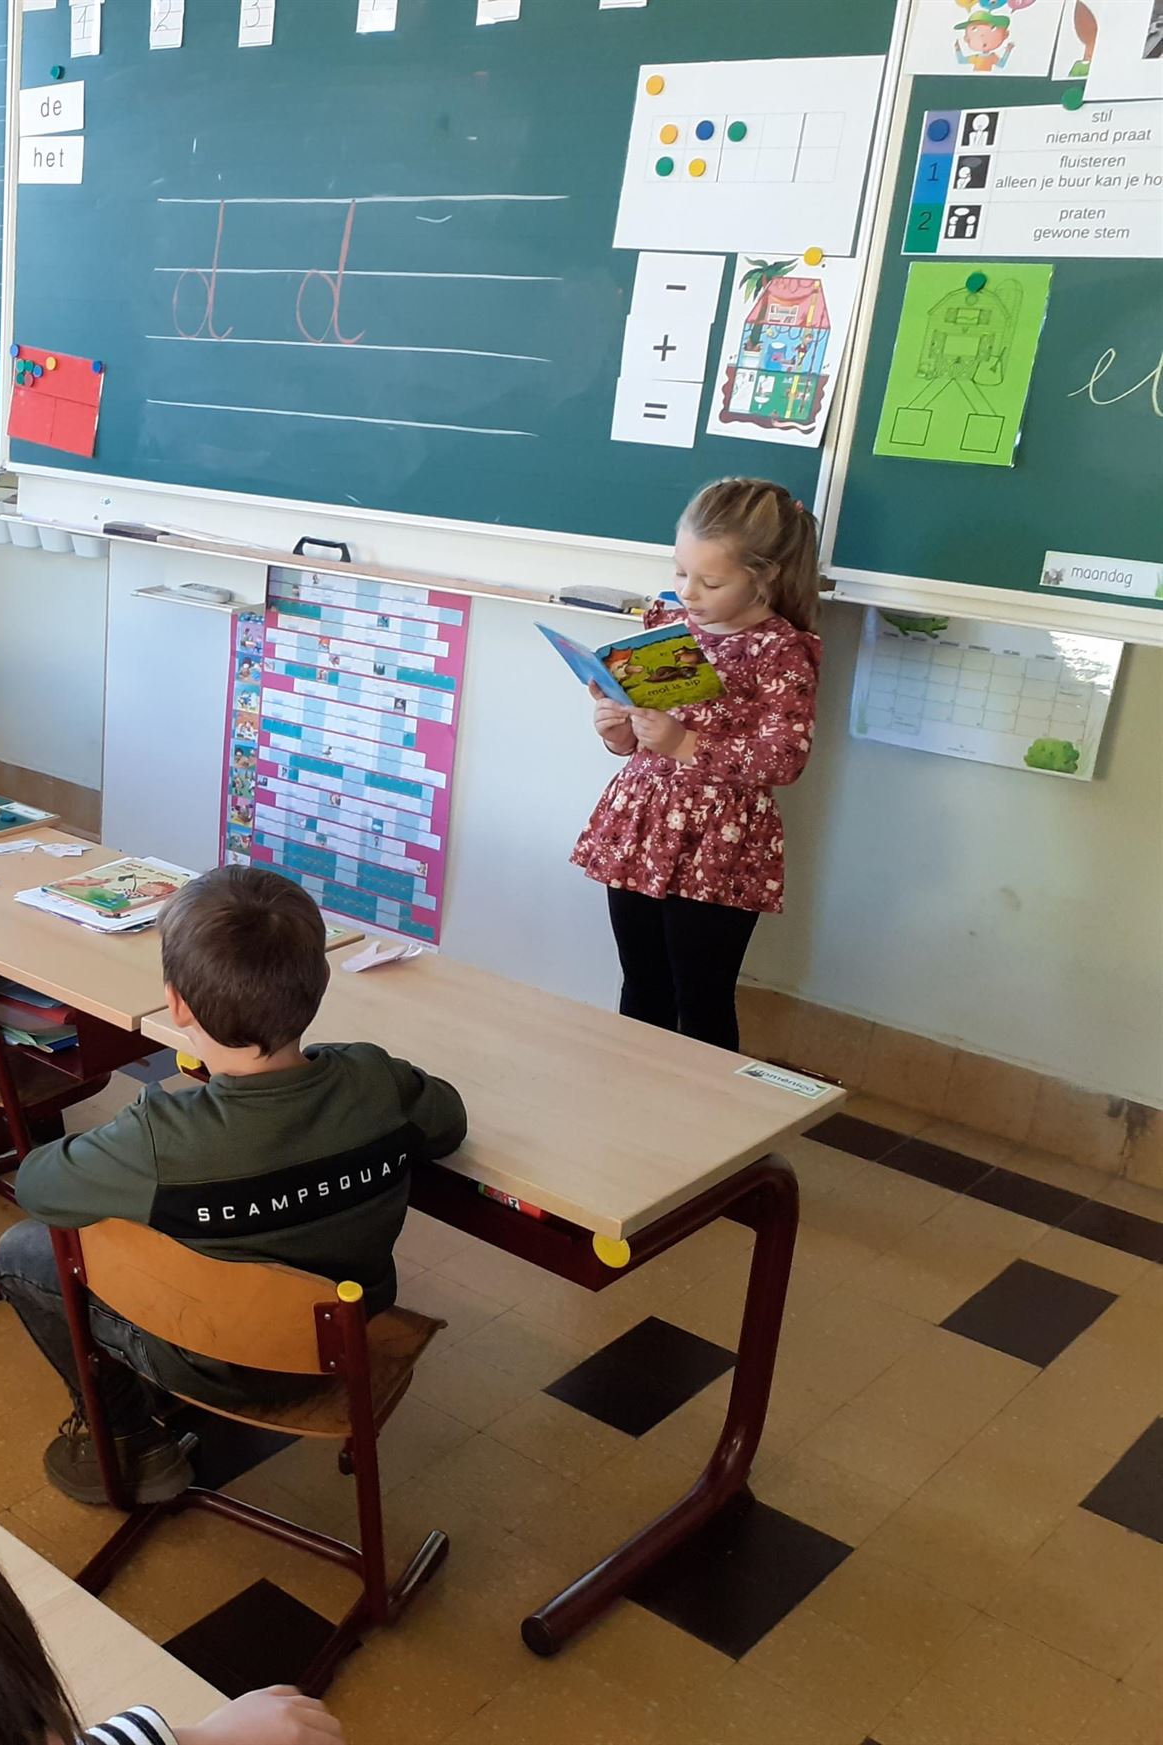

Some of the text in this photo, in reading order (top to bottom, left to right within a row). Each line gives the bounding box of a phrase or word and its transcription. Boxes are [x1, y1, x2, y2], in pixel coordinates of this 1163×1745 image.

[39, 96, 63, 118] de
[1045, 129, 1152, 144] niemand praat
[33, 146, 64, 168] het
[1058, 154, 1126, 169] fluisteren
[926, 162, 940, 182] 1
[995, 175, 1037, 189] alleen
[1039, 173, 1054, 190] je
[1058, 173, 1091, 188] buur
[1094, 173, 1122, 187] kan
[1124, 172, 1140, 190] je
[917, 211, 932, 231] 2
[1058, 207, 1106, 222] praten
[1032, 226, 1130, 242] gewone stem
[1070, 567, 1133, 588] maandag
[647, 685, 669, 696] mol
